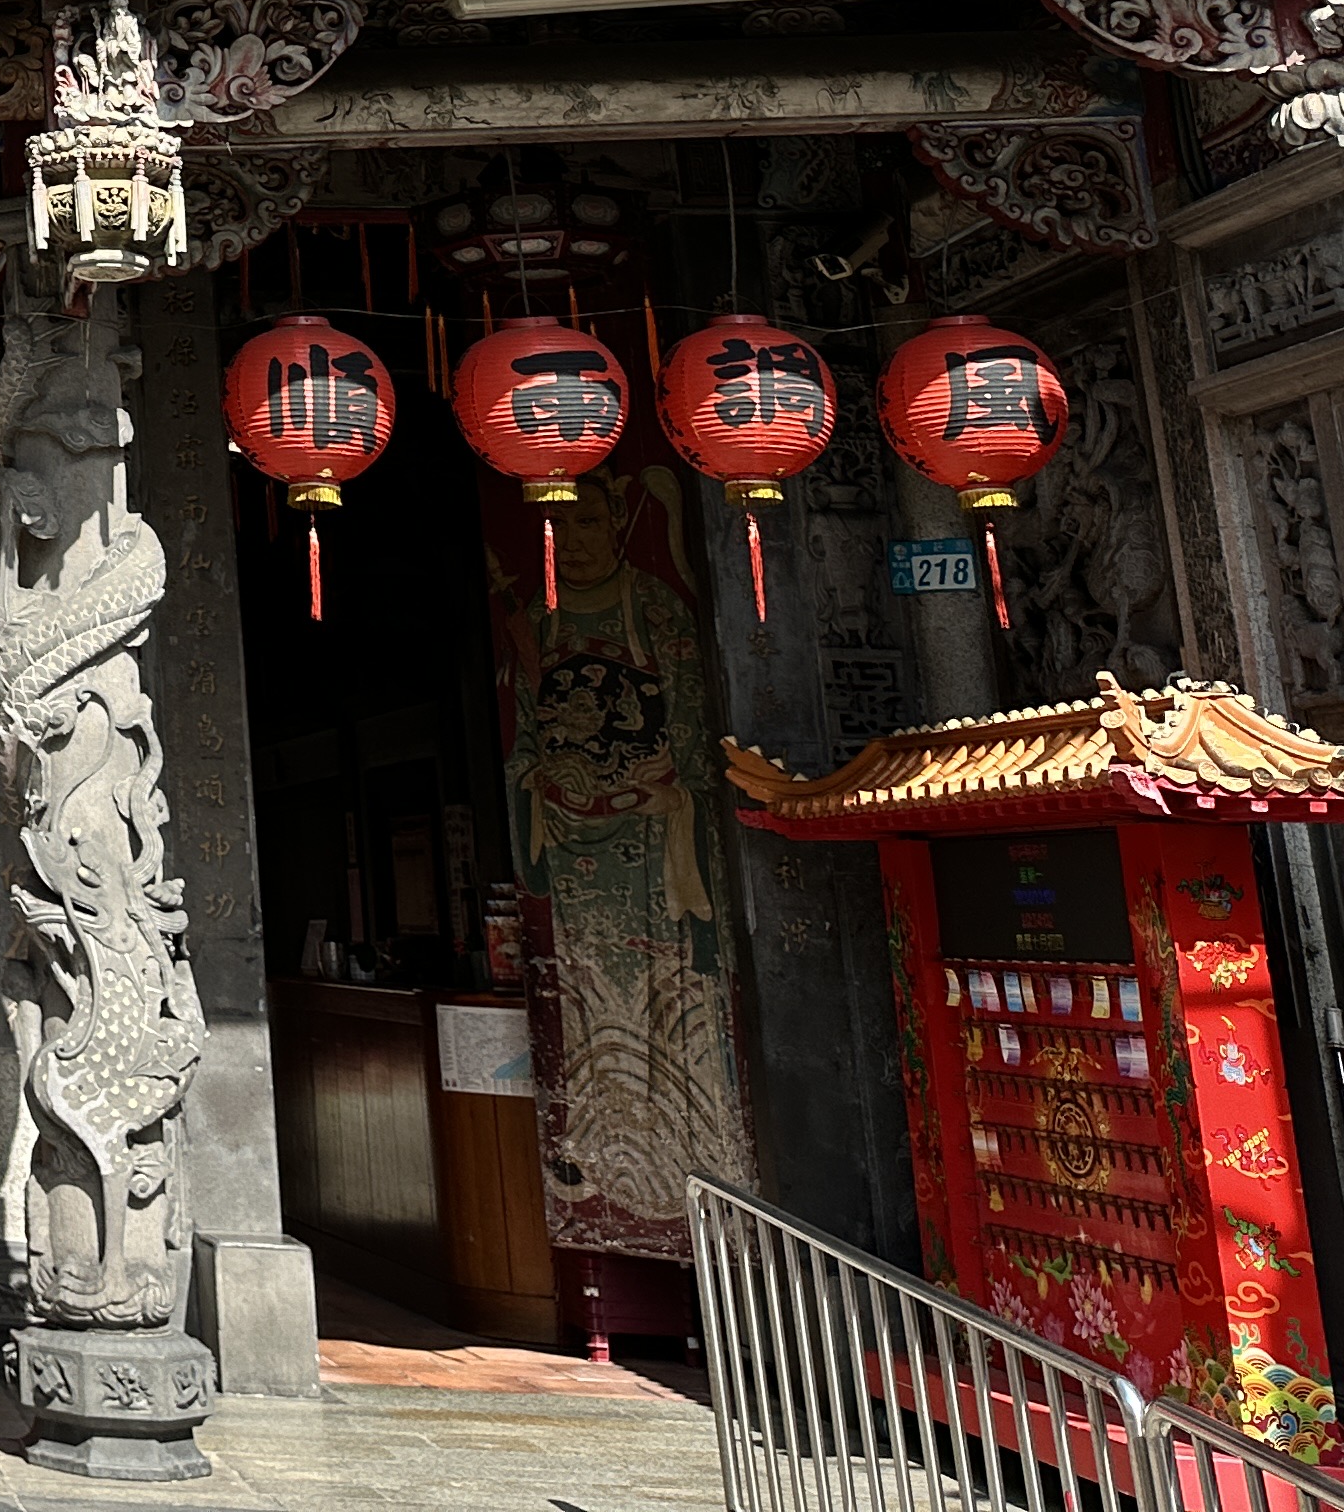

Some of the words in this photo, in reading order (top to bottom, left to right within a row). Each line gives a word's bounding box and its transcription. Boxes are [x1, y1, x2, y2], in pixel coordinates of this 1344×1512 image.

[268, 343, 379, 454] 順
[511, 350, 623, 441] 雨
[706, 338, 823, 435] 調
[918, 558, 969, 586] 218
